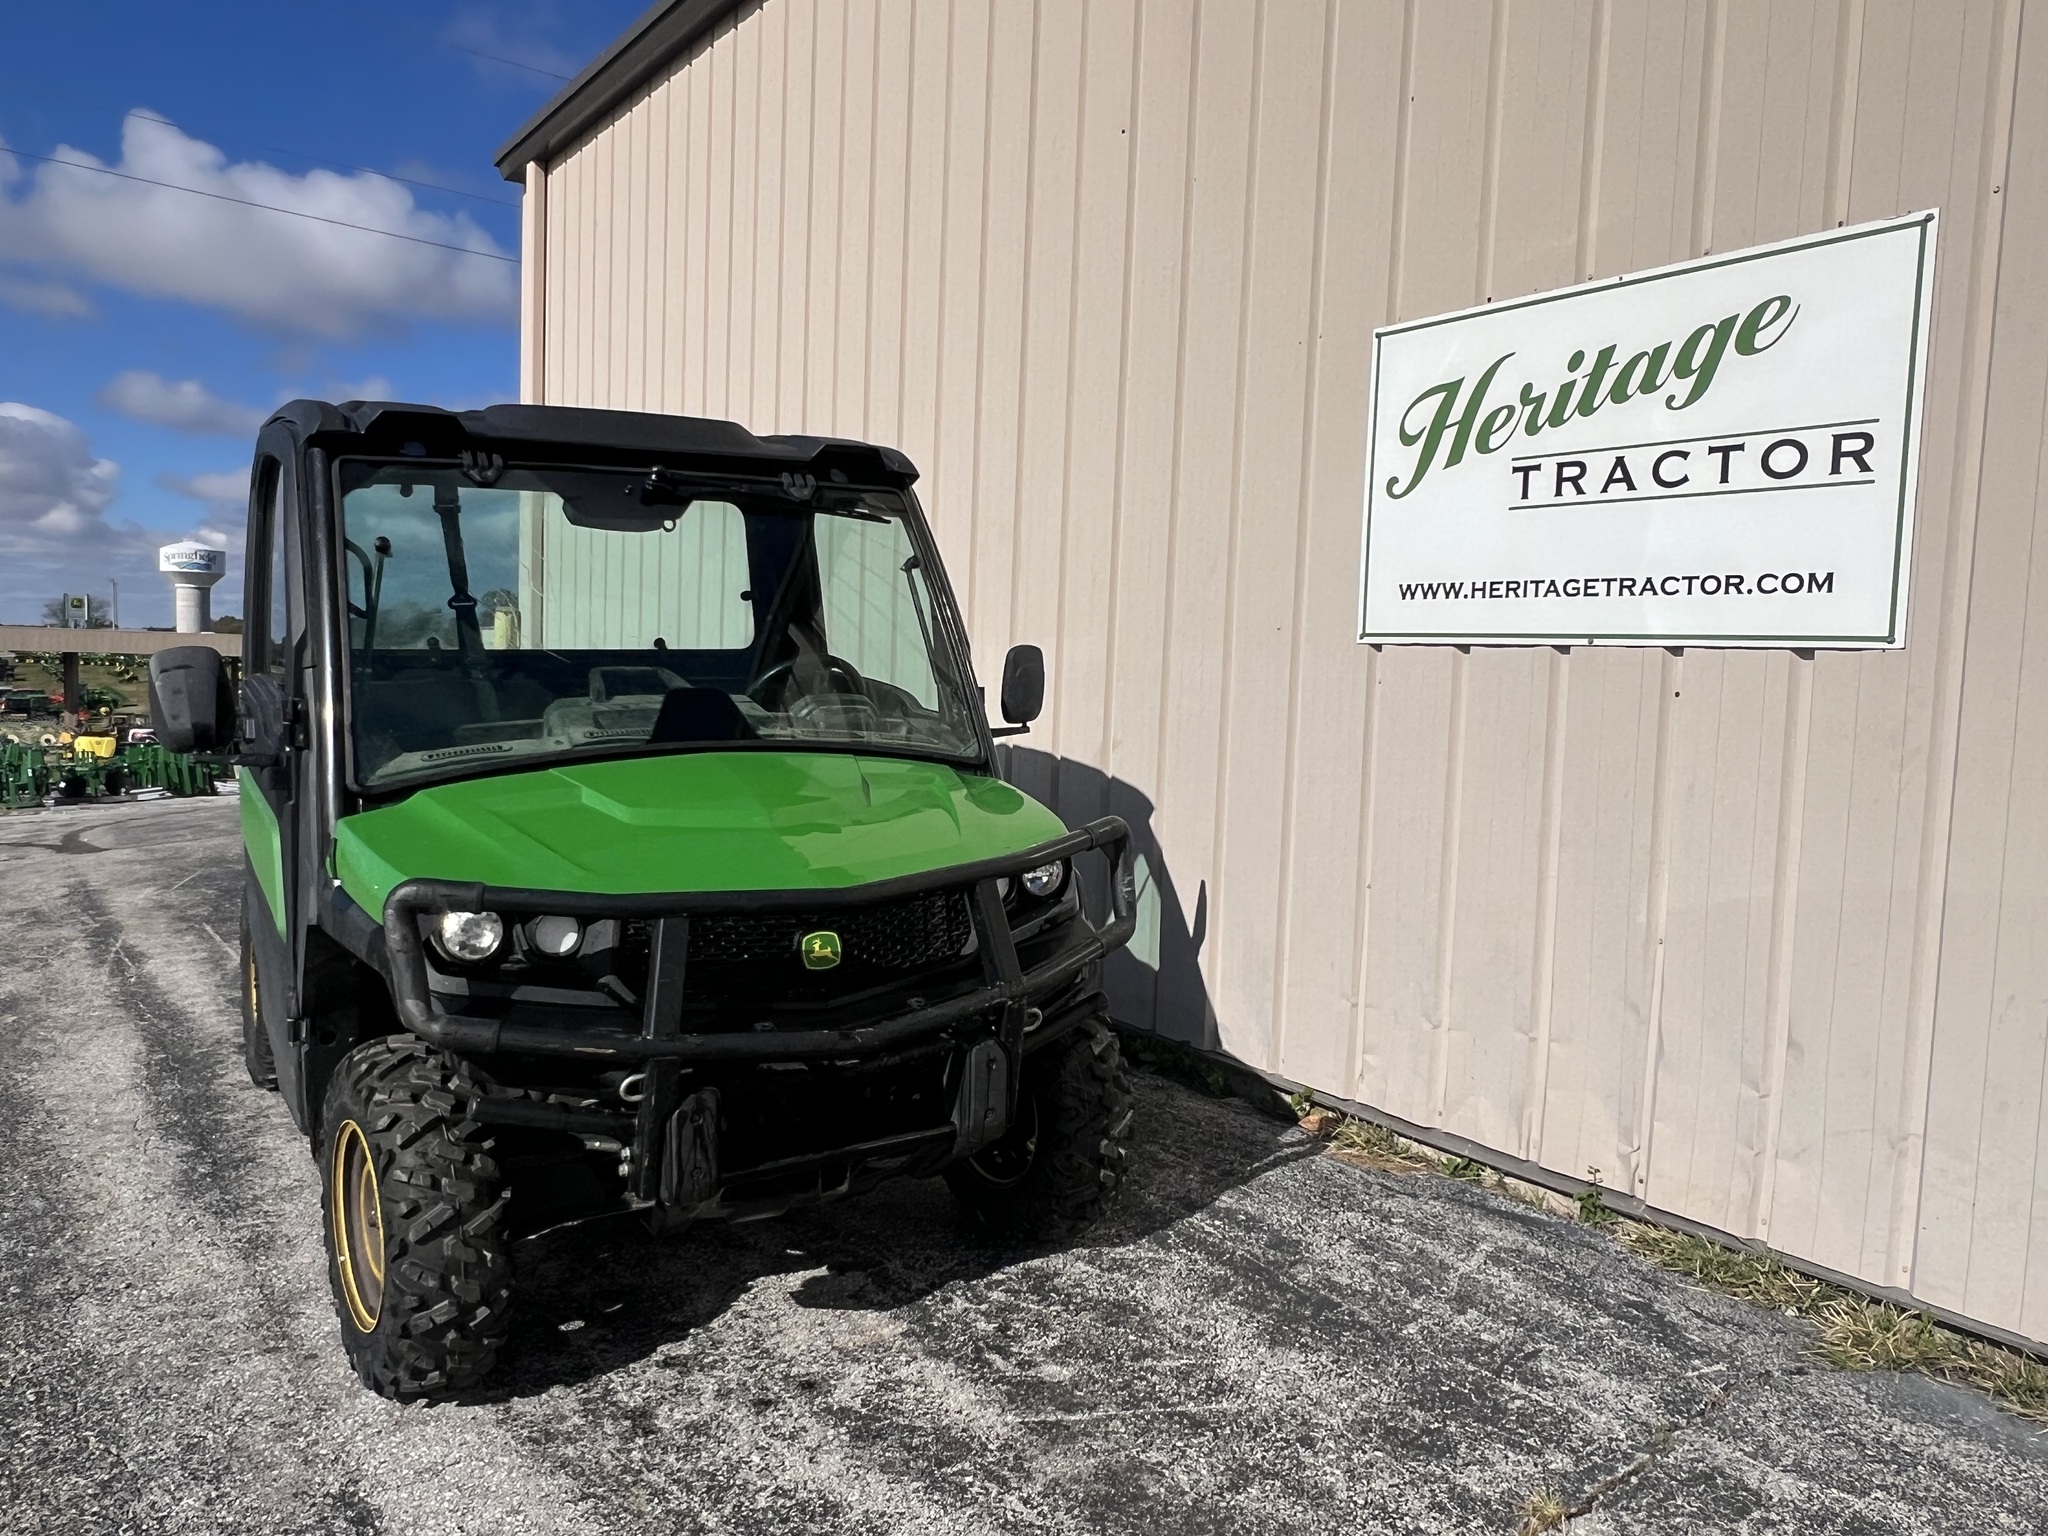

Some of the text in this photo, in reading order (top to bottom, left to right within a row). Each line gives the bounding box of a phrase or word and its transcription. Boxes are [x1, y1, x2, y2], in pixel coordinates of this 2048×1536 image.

[1386, 295, 1800, 499] Heritage
[1512, 431, 1875, 500] TRACTOR
[163, 550, 217, 565] Springfield
[1398, 571, 1835, 600] WWW.HERITAGETRACTOR.COM
